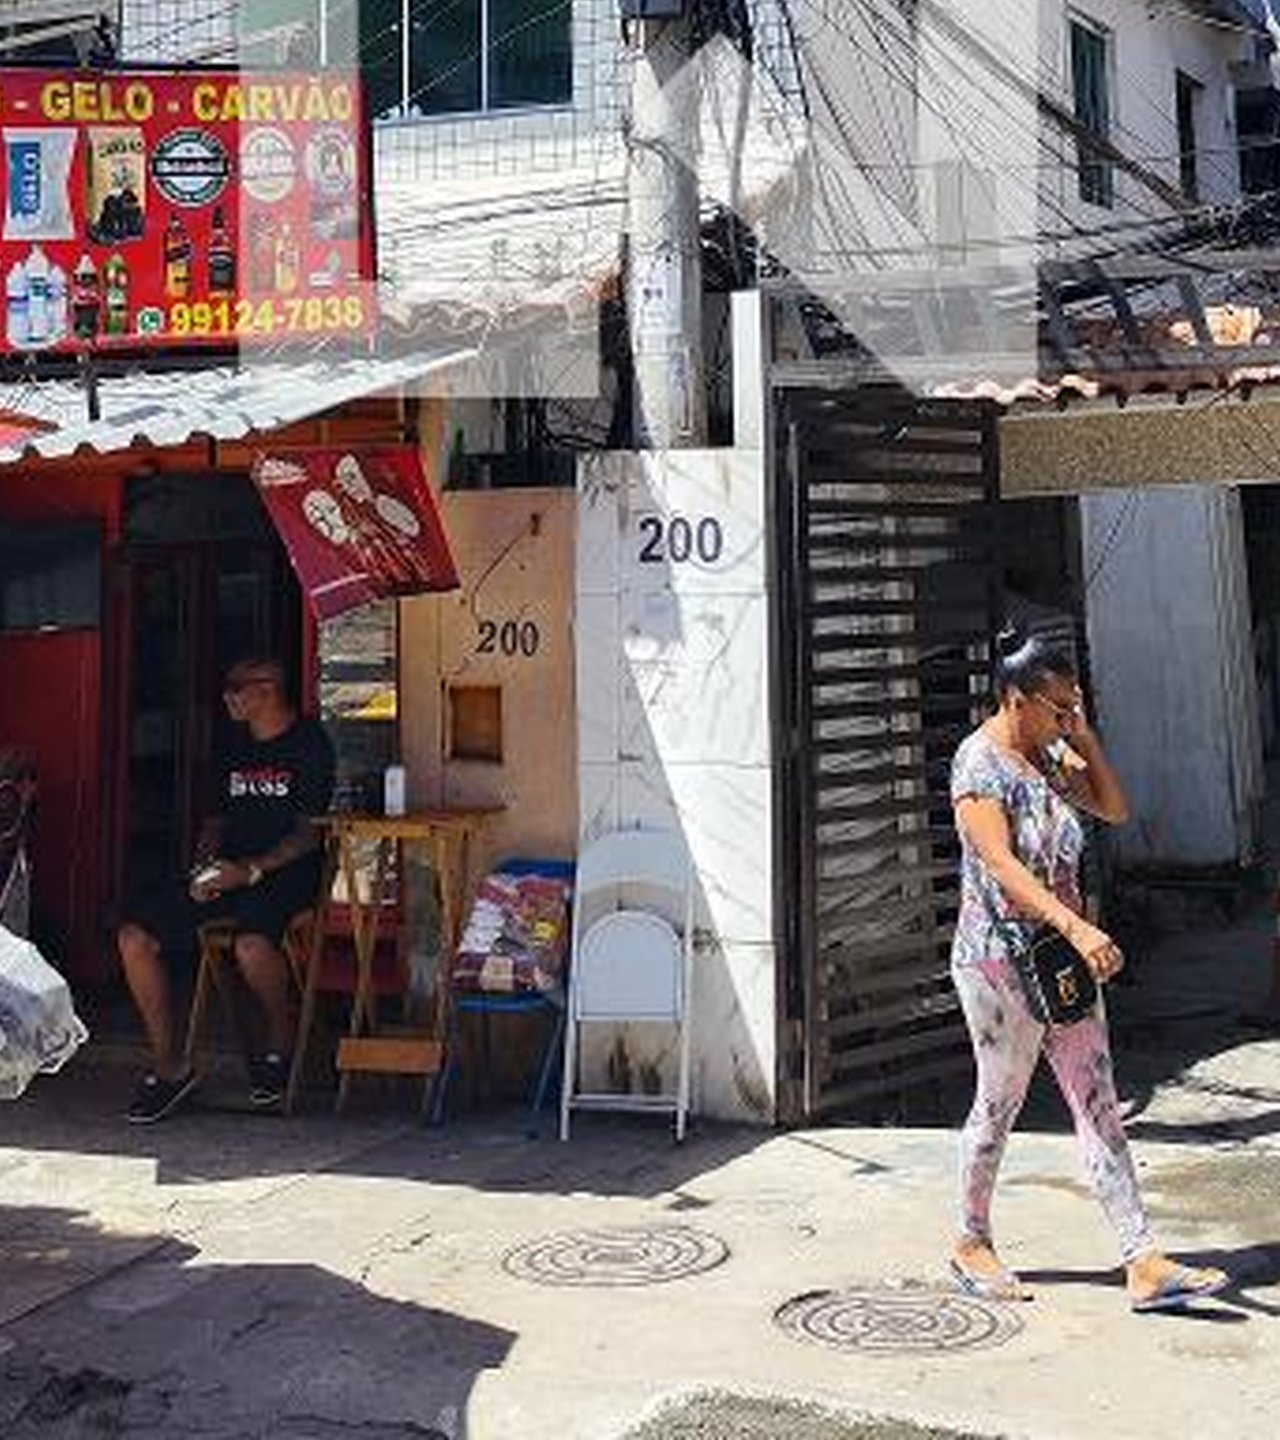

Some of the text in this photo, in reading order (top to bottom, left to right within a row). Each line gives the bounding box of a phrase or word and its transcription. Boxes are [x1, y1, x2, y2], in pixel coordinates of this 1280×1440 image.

[40, 81, 154, 121] GELO
[192, 77, 353, 121] CARVÃO
[171, 295, 364, 336] 99124-7838
[638, 516, 723, 563] 200
[475, 620, 540, 657] 200
